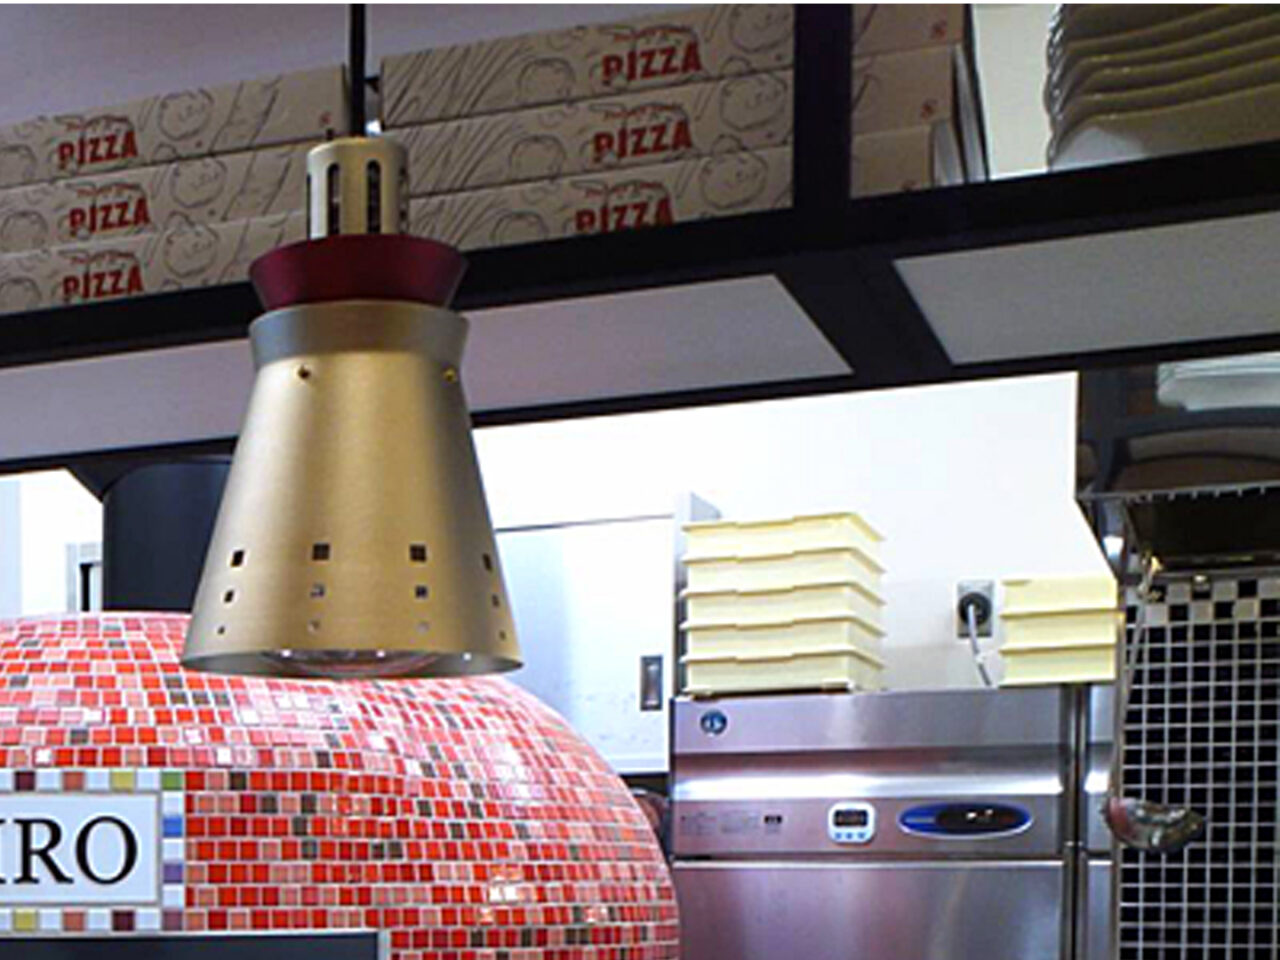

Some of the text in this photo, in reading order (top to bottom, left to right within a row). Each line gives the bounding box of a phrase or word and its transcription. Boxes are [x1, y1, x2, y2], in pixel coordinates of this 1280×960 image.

[602, 40, 702, 85] PIZZA
[58, 131, 138, 169] PIZZA
[593, 119, 693, 162] PIZZA
[70, 197, 151, 236] PIZZA
[575, 196, 675, 232] PIZZA
[62, 265, 144, 302] PIZZA
